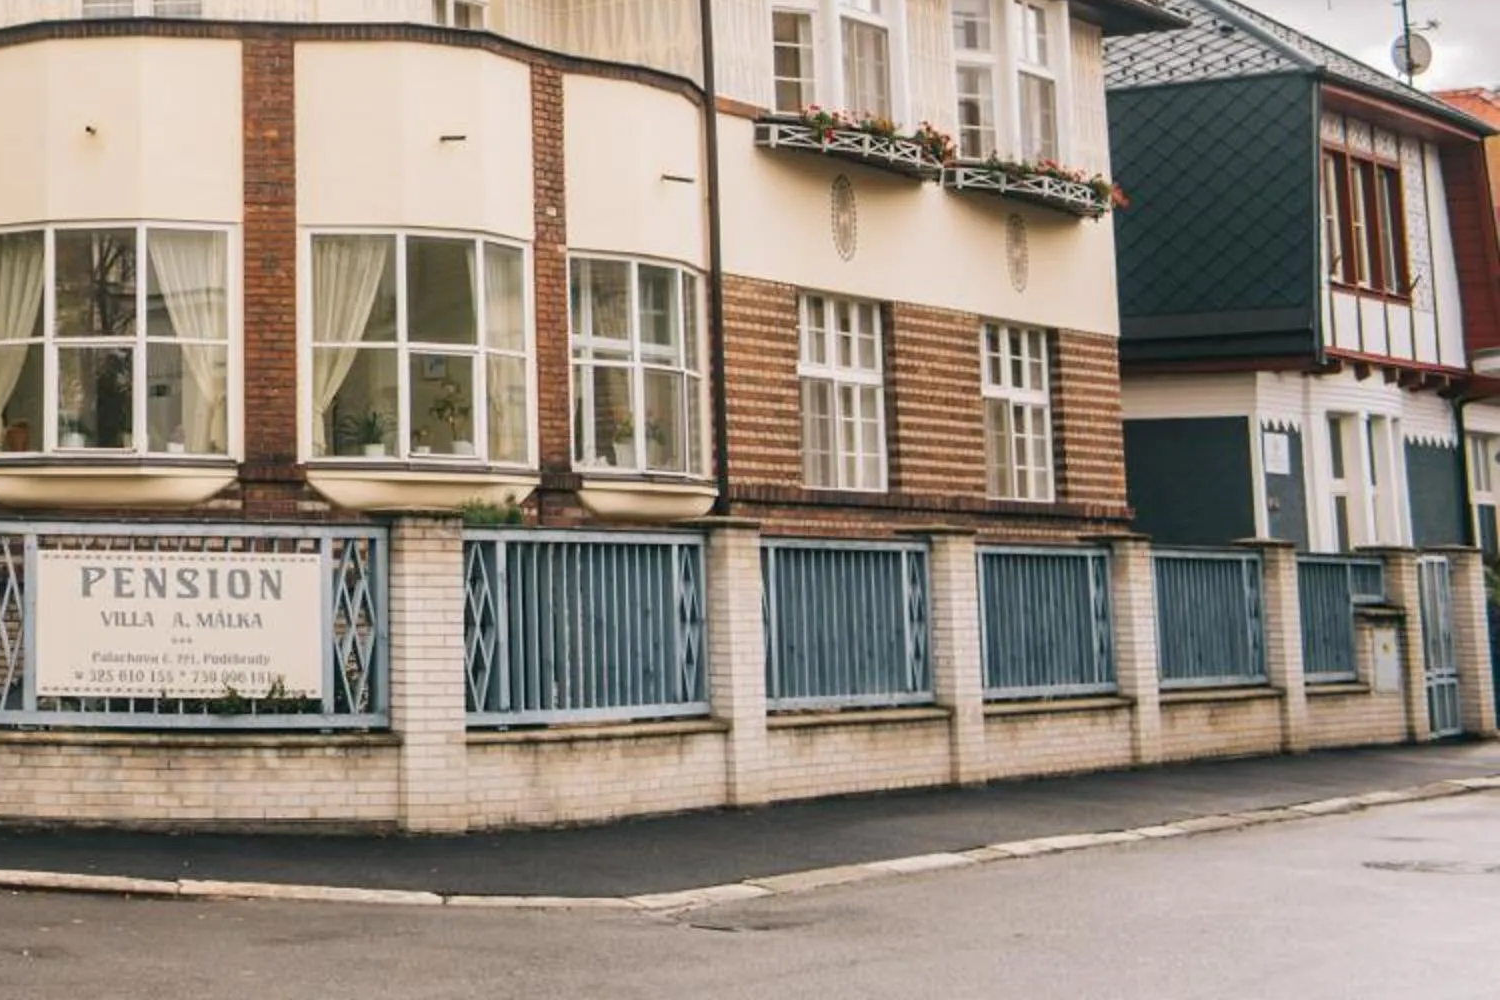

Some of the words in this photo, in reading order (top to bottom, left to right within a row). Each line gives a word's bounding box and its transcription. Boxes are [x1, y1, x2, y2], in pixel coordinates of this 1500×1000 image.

[81, 566, 282, 600] PENSION
[100, 611, 154, 628] VILLA
[172, 611, 191, 629] A.
[196, 609, 263, 629] MÁLKA
